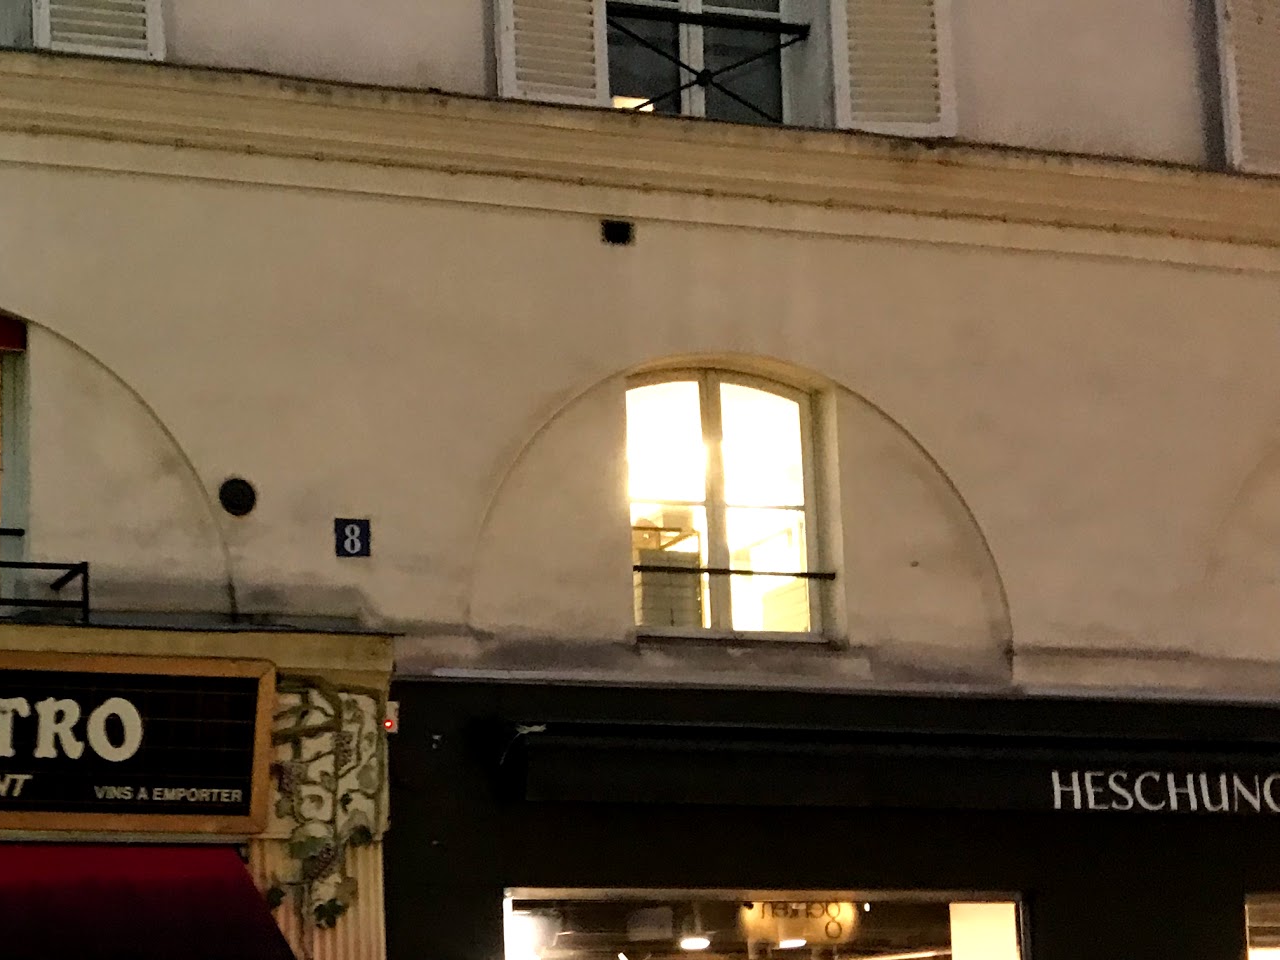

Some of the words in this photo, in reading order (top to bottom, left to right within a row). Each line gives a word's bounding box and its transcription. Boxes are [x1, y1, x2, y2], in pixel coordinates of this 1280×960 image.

[343, 523, 362, 554] 8
[93, 785, 134, 800] VINS
[136, 786, 150, 801] A
[151, 787, 243, 803] EMPORTER
